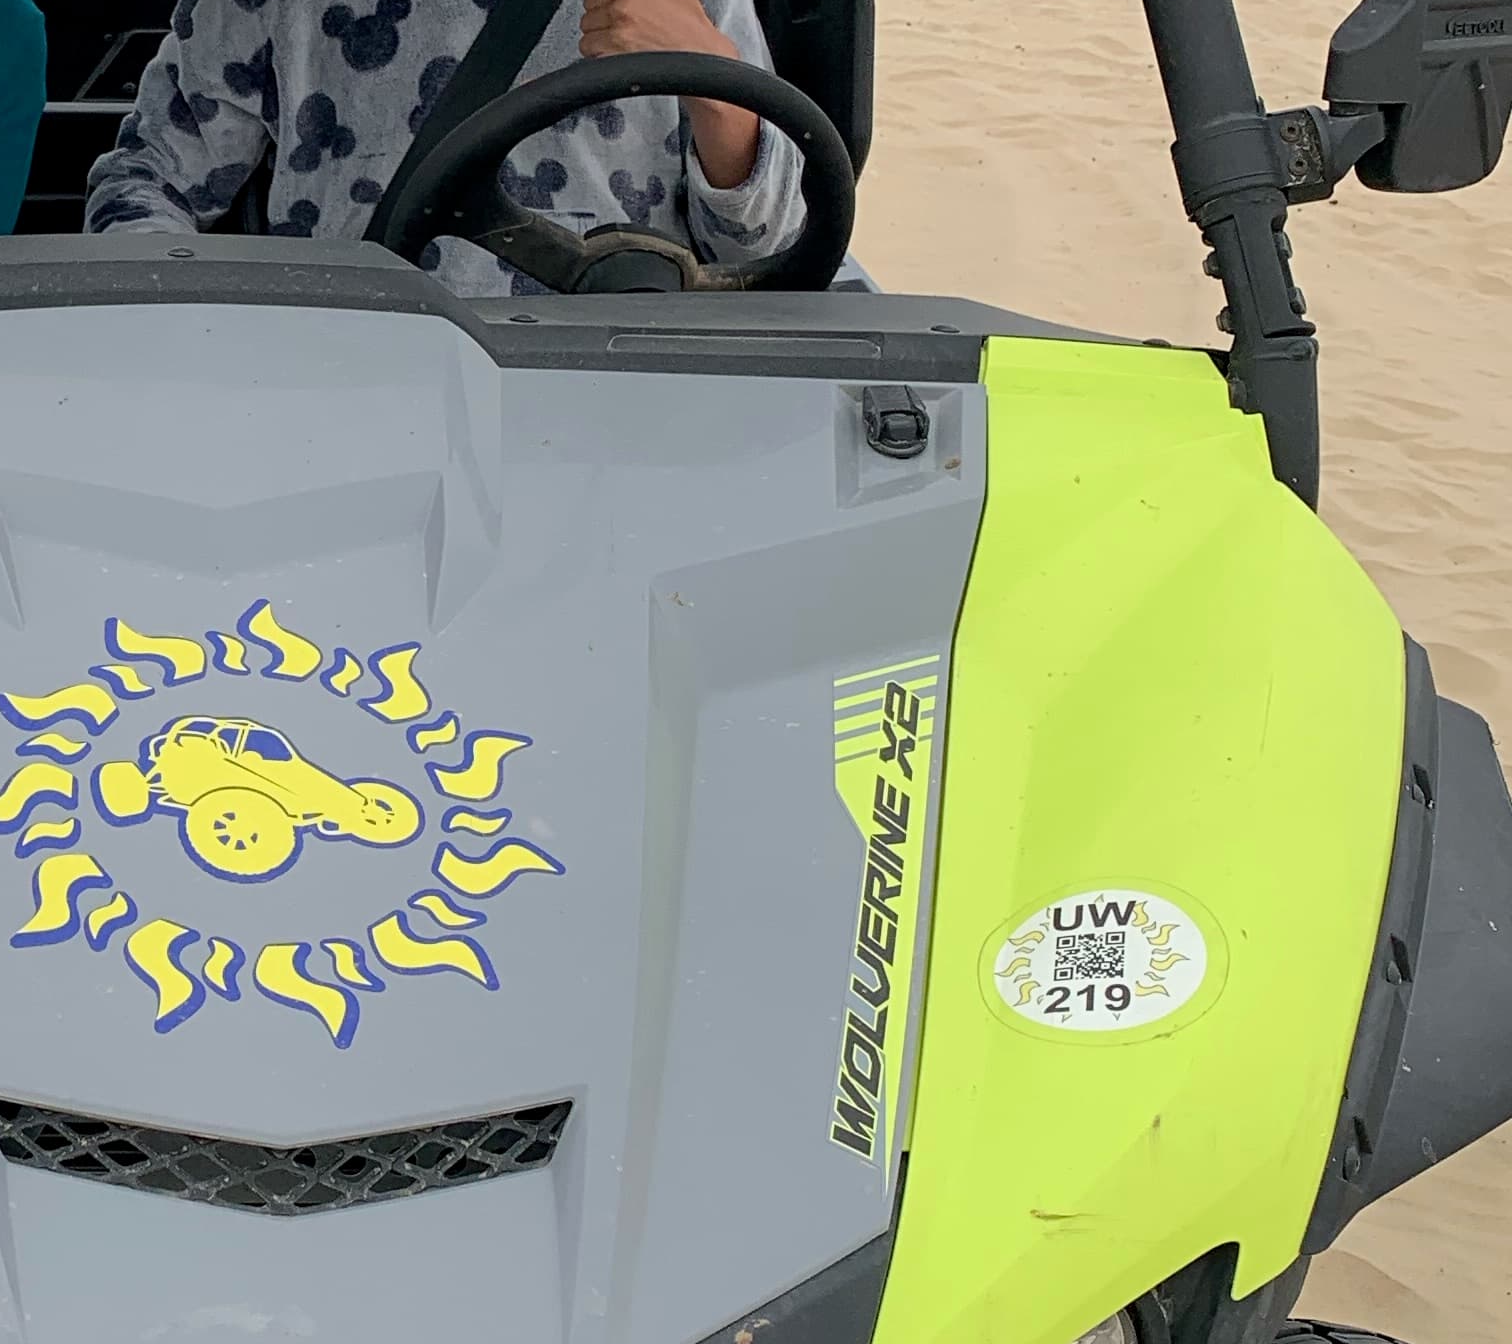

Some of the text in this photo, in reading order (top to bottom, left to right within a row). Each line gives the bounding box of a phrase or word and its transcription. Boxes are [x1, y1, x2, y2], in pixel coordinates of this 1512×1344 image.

[831, 680, 920, 1157] WOLVERINE X2
[1052, 900, 1137, 932] UW
[1044, 983, 1132, 1014] 219
